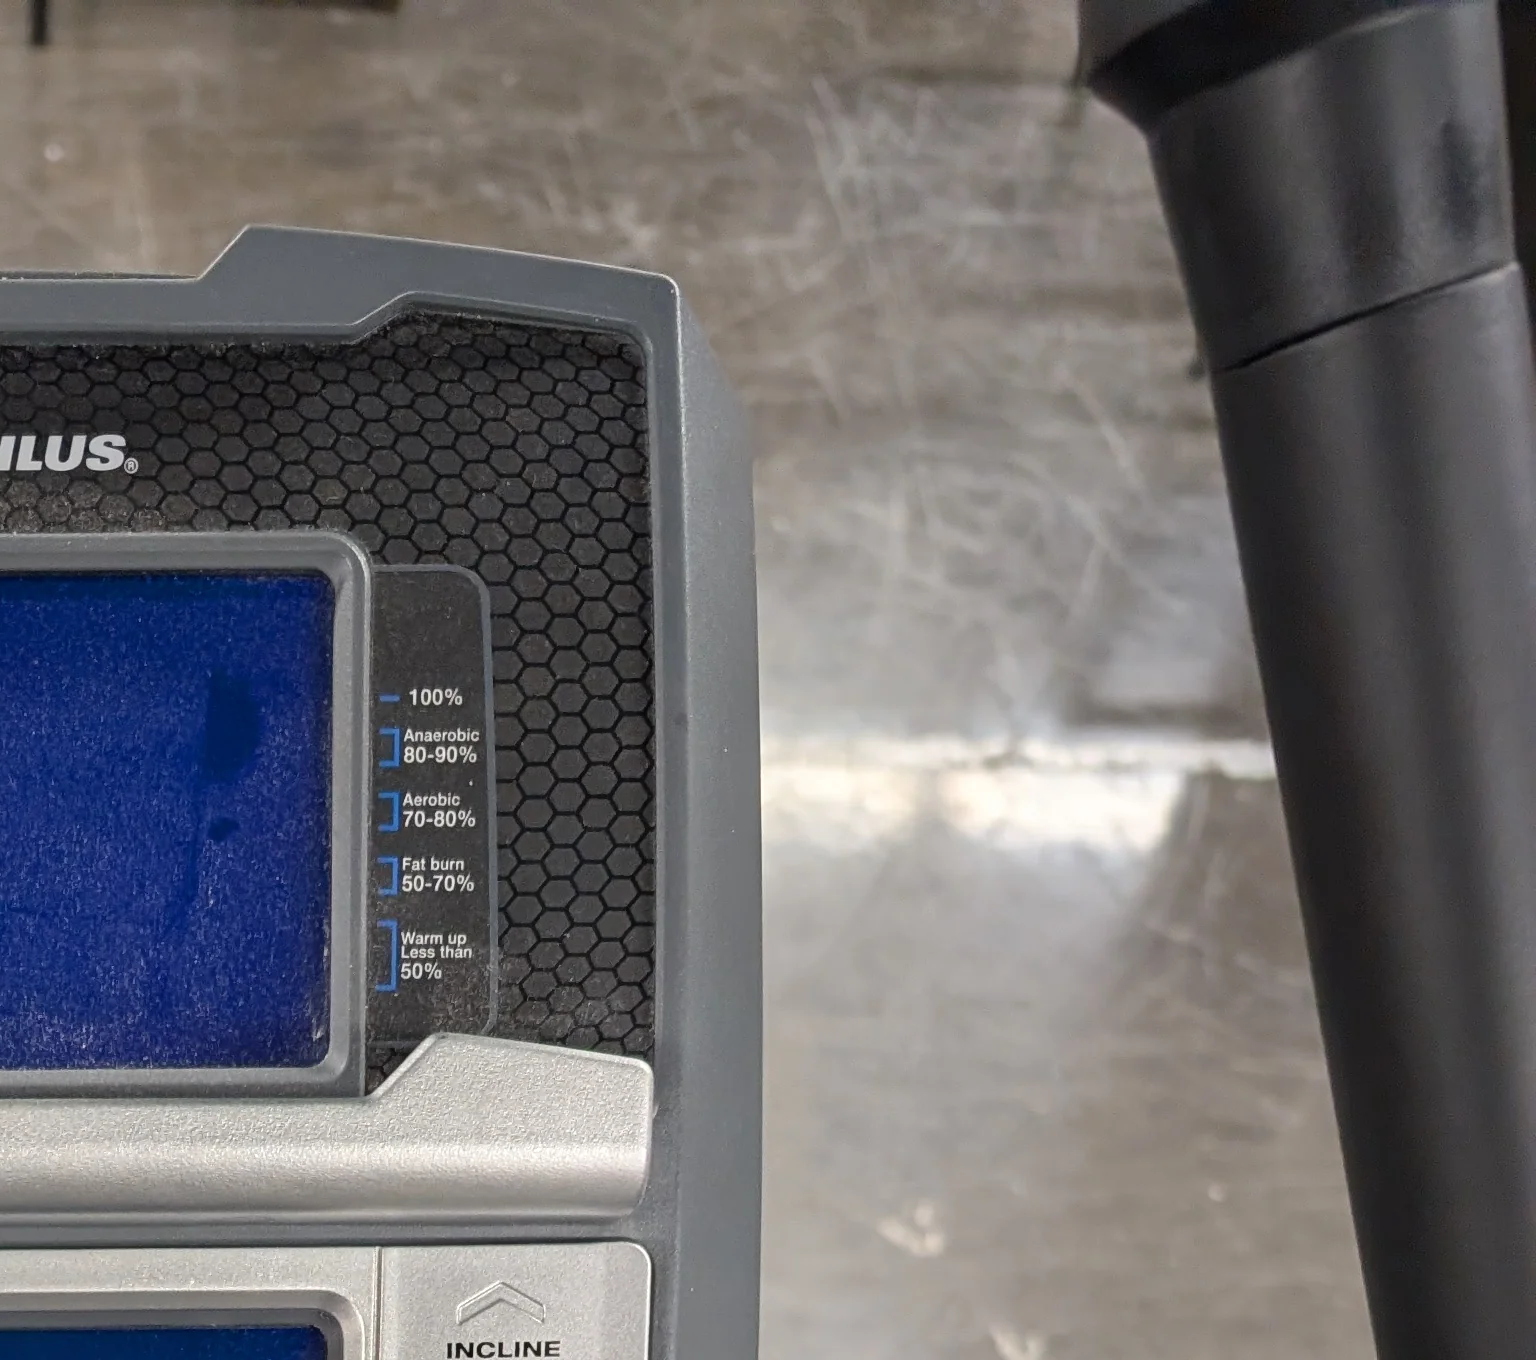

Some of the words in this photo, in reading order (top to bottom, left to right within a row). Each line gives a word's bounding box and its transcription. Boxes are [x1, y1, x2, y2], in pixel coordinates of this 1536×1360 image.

[409, 688, 463, 706] 100%
[403, 727, 480, 743] Anaerobic
[403, 745, 477, 764] 80-90%
[402, 792, 461, 807] Aerobic
[402, 809, 476, 828] 70-80%
[402, 857, 426, 871] Fat
[430, 856, 465, 871] burn
[401, 874, 475, 892] 50-70%
[400, 931, 444, 946] Warm
[447, 934, 467, 948] up
[400, 945, 436, 959] Less
[439, 944, 473, 959] than
[400, 962, 442, 980] 50%
[446, 1340, 561, 1359] INCLINE
